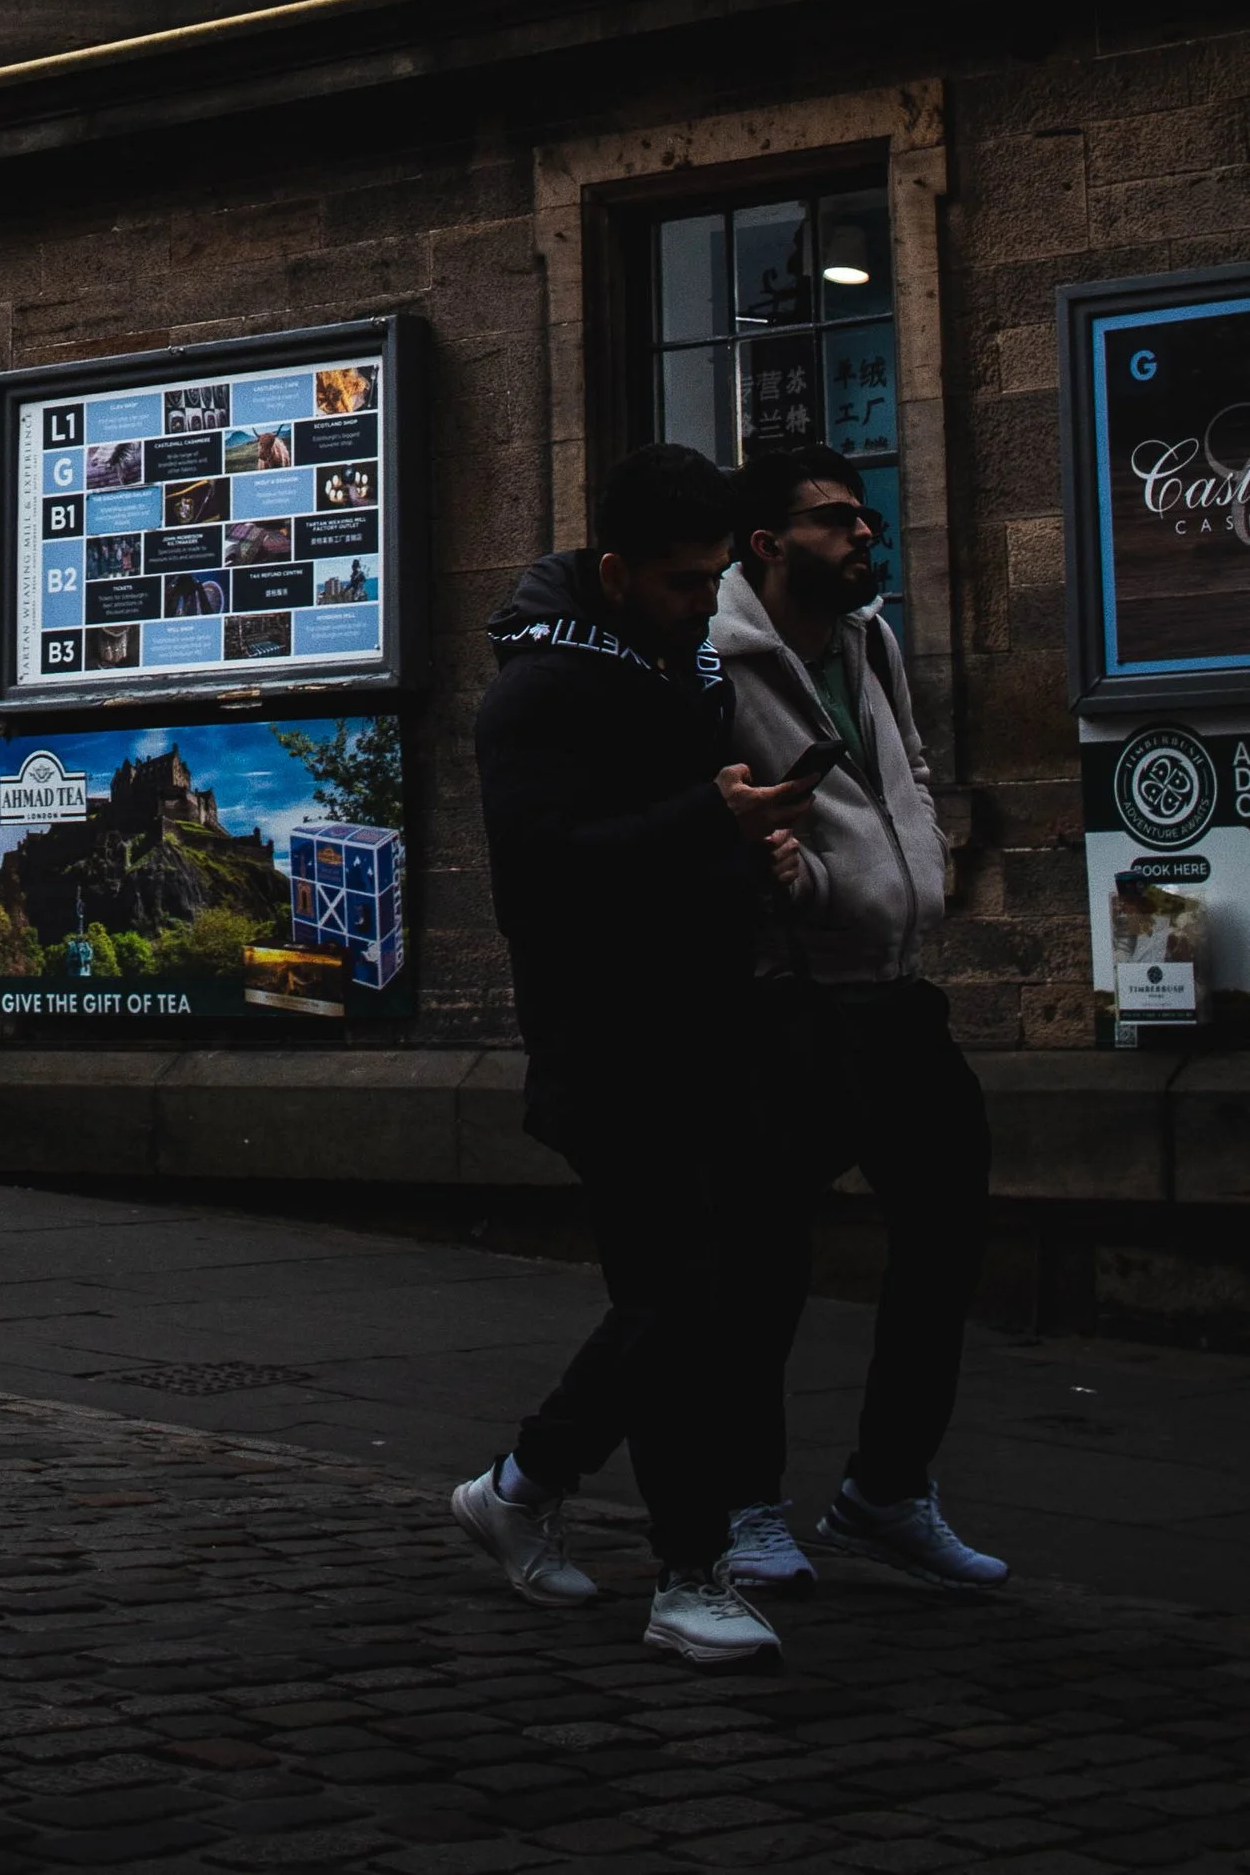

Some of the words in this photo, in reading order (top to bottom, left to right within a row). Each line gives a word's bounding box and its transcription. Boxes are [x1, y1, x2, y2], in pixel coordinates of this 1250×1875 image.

[1129, 348, 1158, 382] G
[51, 412, 75, 442] L1
[53, 457, 73, 486] G
[50, 504, 75, 531] B1
[47, 567, 78, 594] B2
[48, 640, 76, 664] B3
[551, 619, 647, 668] VETTI
[2, 788, 54, 809] AHMAD
[56, 786, 84, 806] TEA
[27, 812, 59, 820] LONDON
[1122, 801, 1179, 838] ADVENTURE
[1180, 798, 1210, 834] AWAITS
[1173, 863, 1208, 876] HERE
[1, 993, 42, 1013] GIVE
[46, 993, 78, 1013] THE
[83, 993, 122, 1014] GIFT
[127, 993, 153, 1014] OF
[157, 993, 192, 1014] TEA
